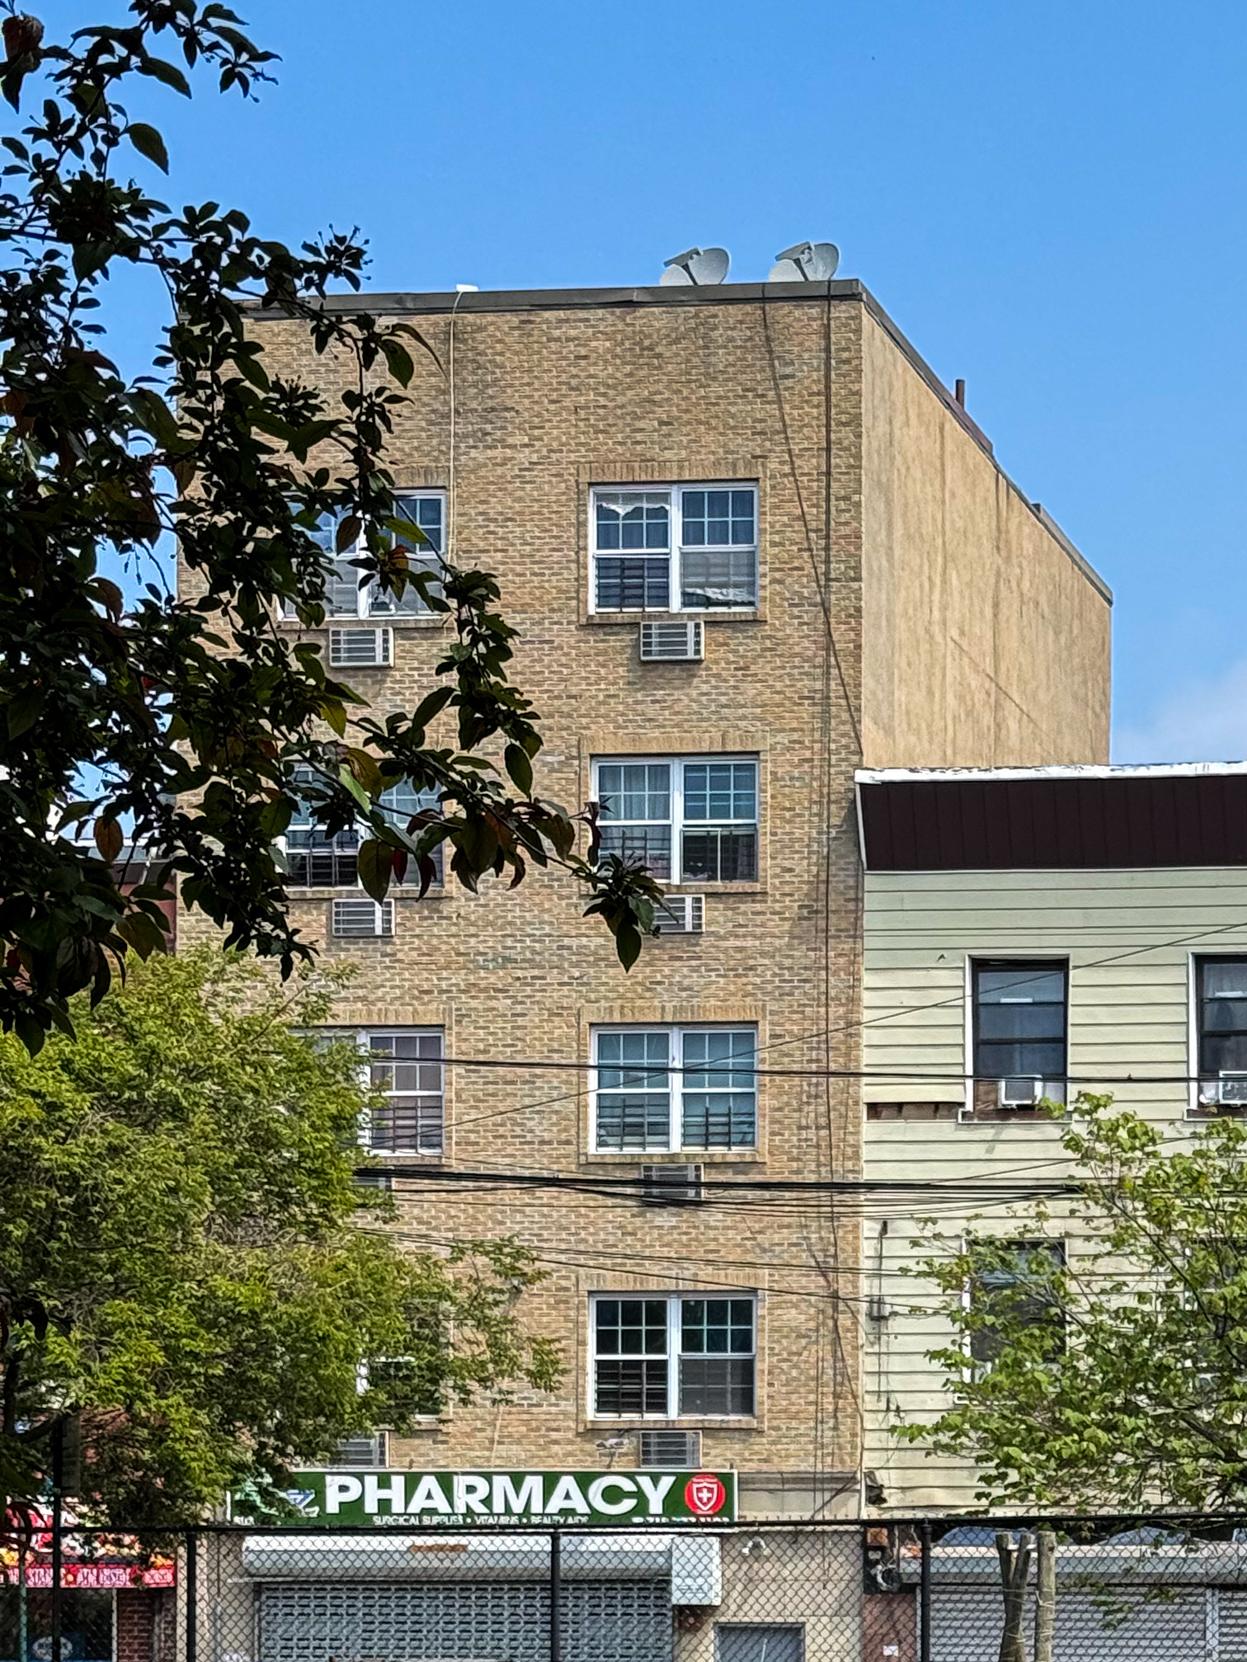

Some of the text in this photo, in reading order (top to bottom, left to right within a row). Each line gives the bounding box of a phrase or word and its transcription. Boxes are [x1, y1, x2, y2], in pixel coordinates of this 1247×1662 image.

[325, 1473, 677, 1514] PHARMACY
[373, 1515, 419, 1525] SURGICAL
[423, 1515, 463, 1525] SUPPLIES
[475, 1515, 519, 1525] VITAMINS
